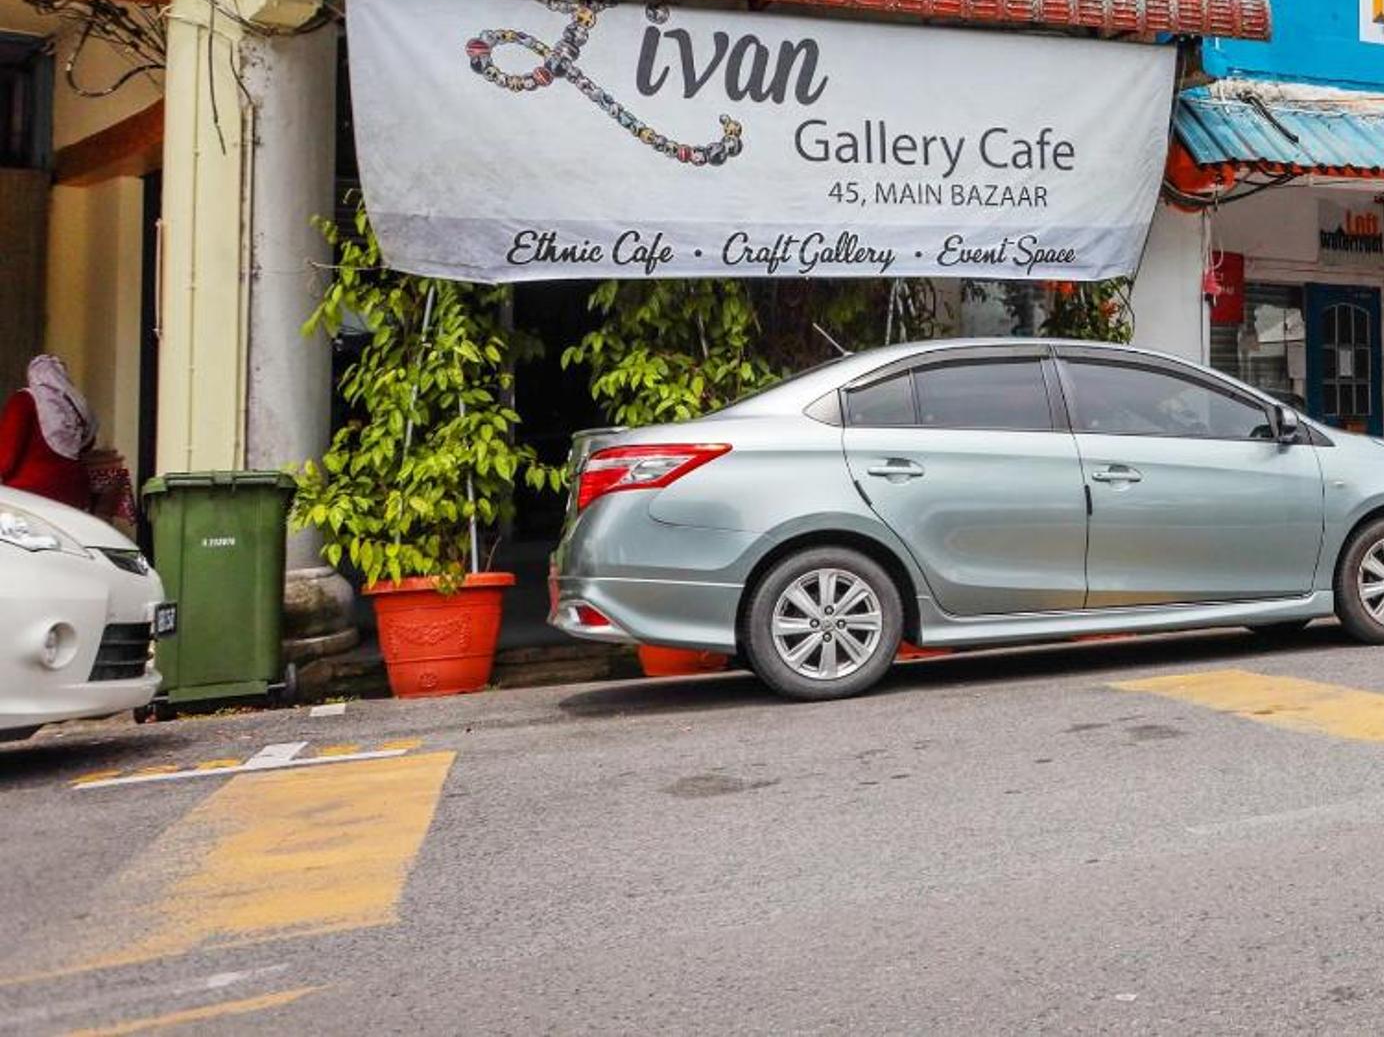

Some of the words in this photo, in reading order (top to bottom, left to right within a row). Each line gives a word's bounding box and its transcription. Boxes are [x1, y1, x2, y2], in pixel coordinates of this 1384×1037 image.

[794, 119, 967, 178] Gallery
[978, 125, 1077, 172] Cafe
[828, 181, 867, 208] 45,
[875, 184, 944, 207] MAIN
[950, 184, 1049, 210] BAZAAR
[507, 229, 603, 266] Ethnic
[611, 229, 676, 267] Cafe
[721, 230, 796, 269] Craft
[797, 232, 896, 275] Gallery
[936, 236, 1014, 266] Event
[1015, 238, 1076, 269] Space
